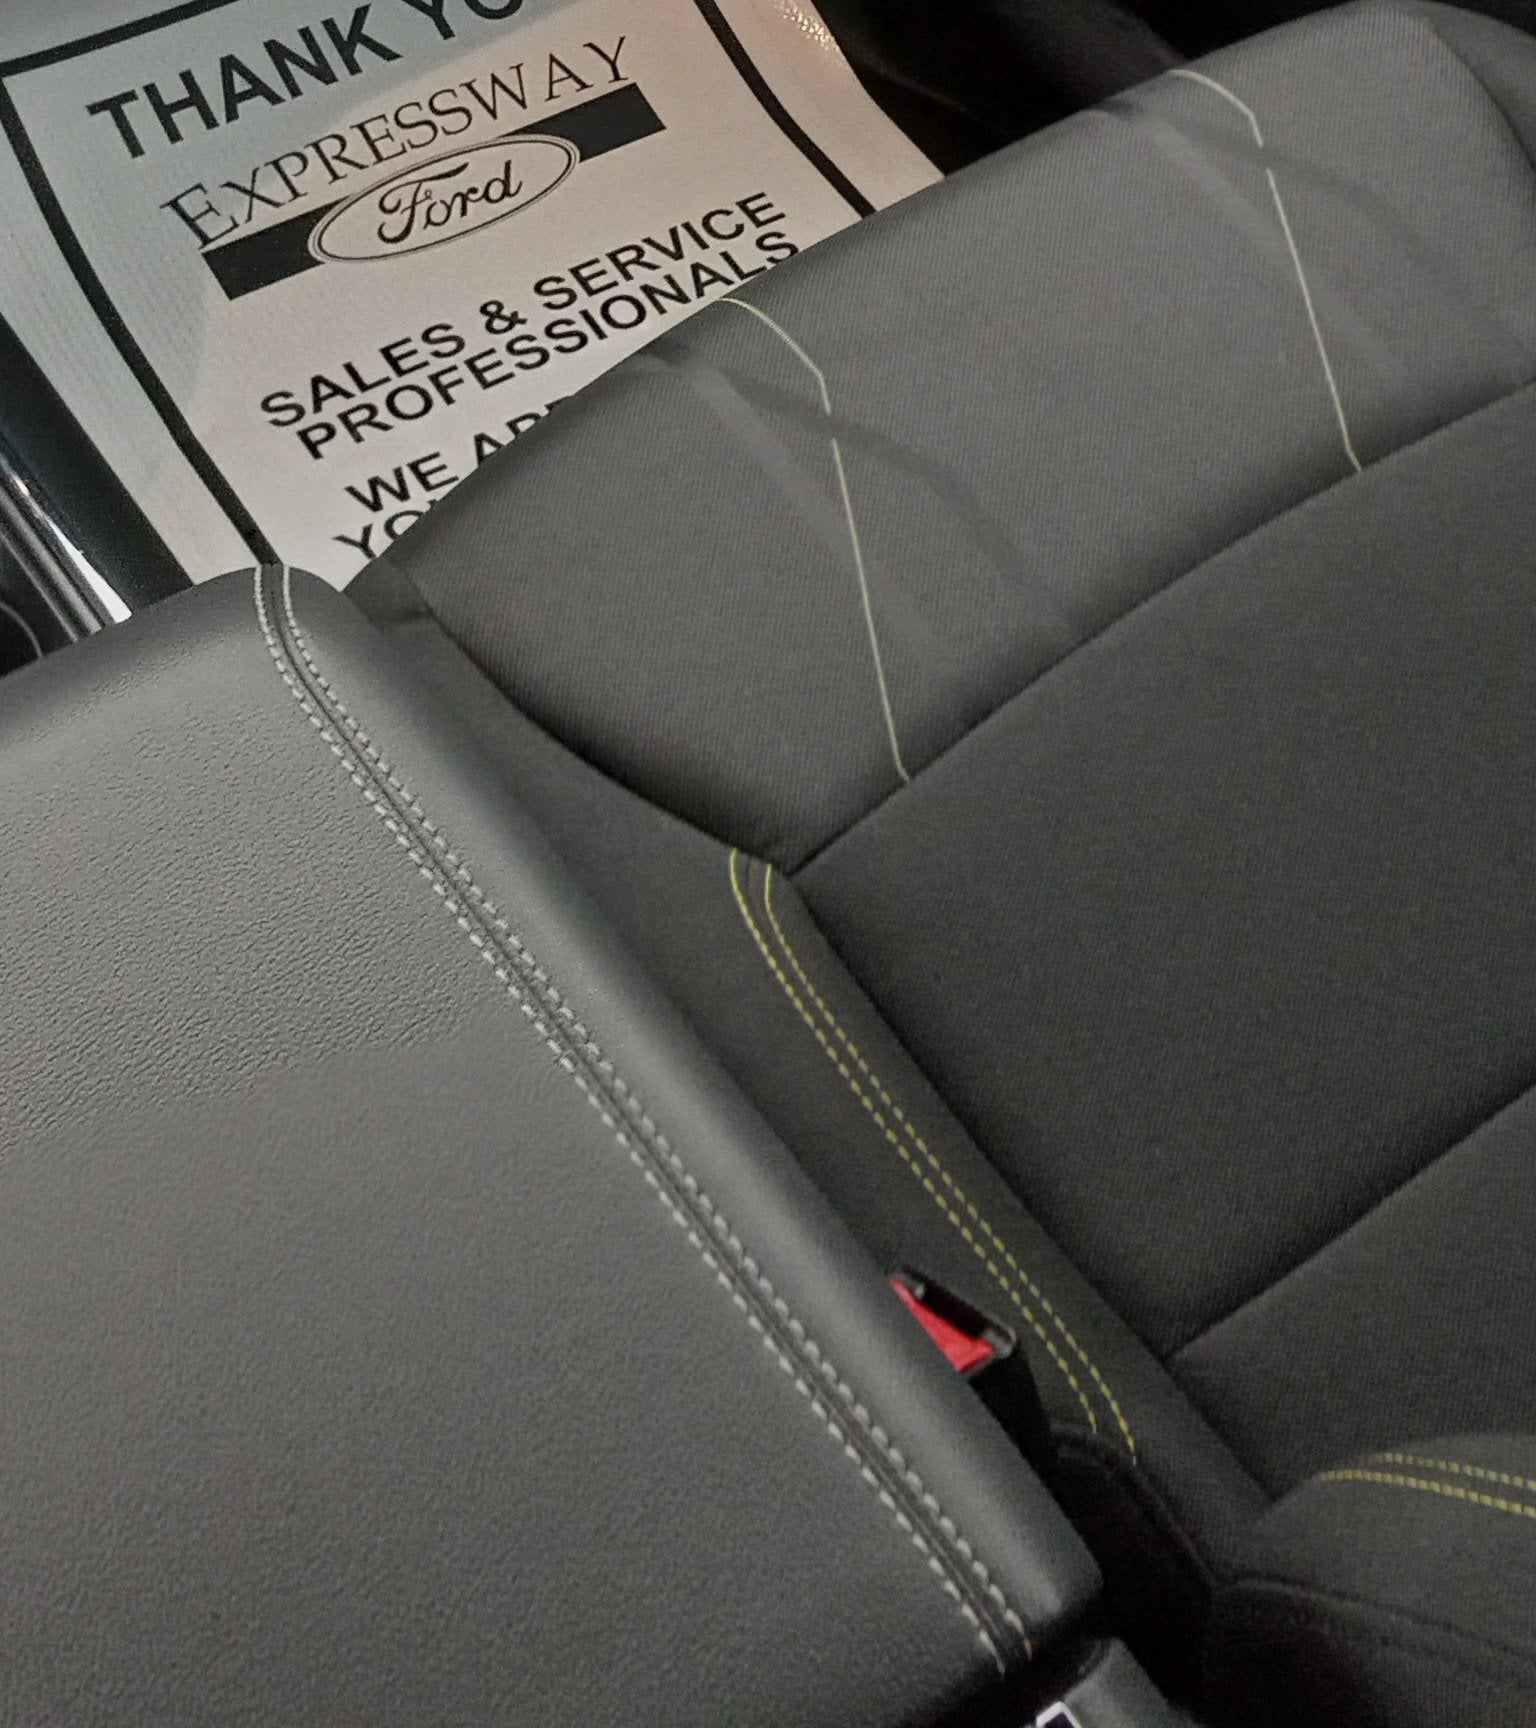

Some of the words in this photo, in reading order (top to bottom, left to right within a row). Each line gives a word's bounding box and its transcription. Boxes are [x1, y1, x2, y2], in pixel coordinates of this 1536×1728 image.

[87, 2, 402, 160] THANK
[161, 34, 633, 250] EXPRESSWAY
[375, 158, 523, 247] Ford
[257, 320, 467, 430] SALES
[477, 298, 528, 337] &
[531, 190, 788, 314] SERVICE
[295, 228, 802, 461] PROFESSIONALS
[332, 498, 439, 561] YO
[344, 451, 460, 514] WE
